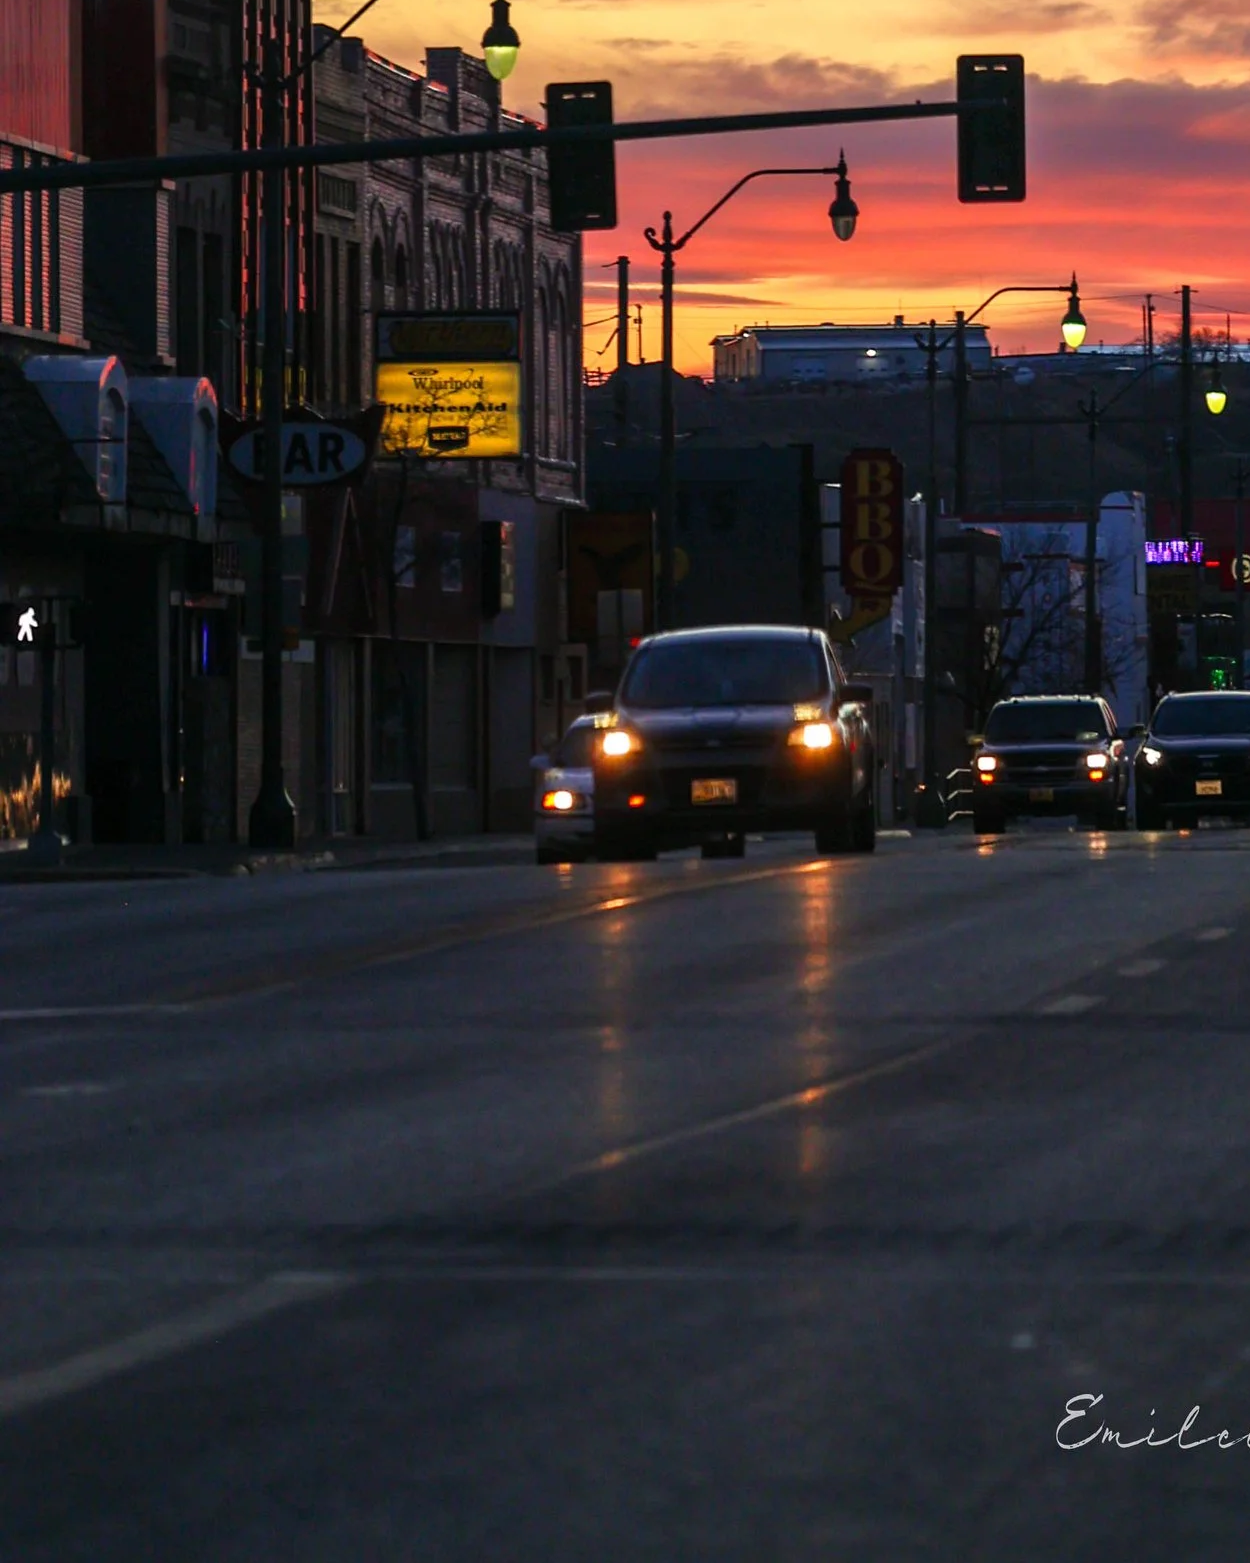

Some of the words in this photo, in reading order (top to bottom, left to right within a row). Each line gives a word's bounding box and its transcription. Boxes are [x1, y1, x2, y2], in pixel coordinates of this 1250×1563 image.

[412, 376, 484, 391] Whirlpool
[389, 402, 508, 414] KitchenAid
[849, 459, 895, 591] BBQ
